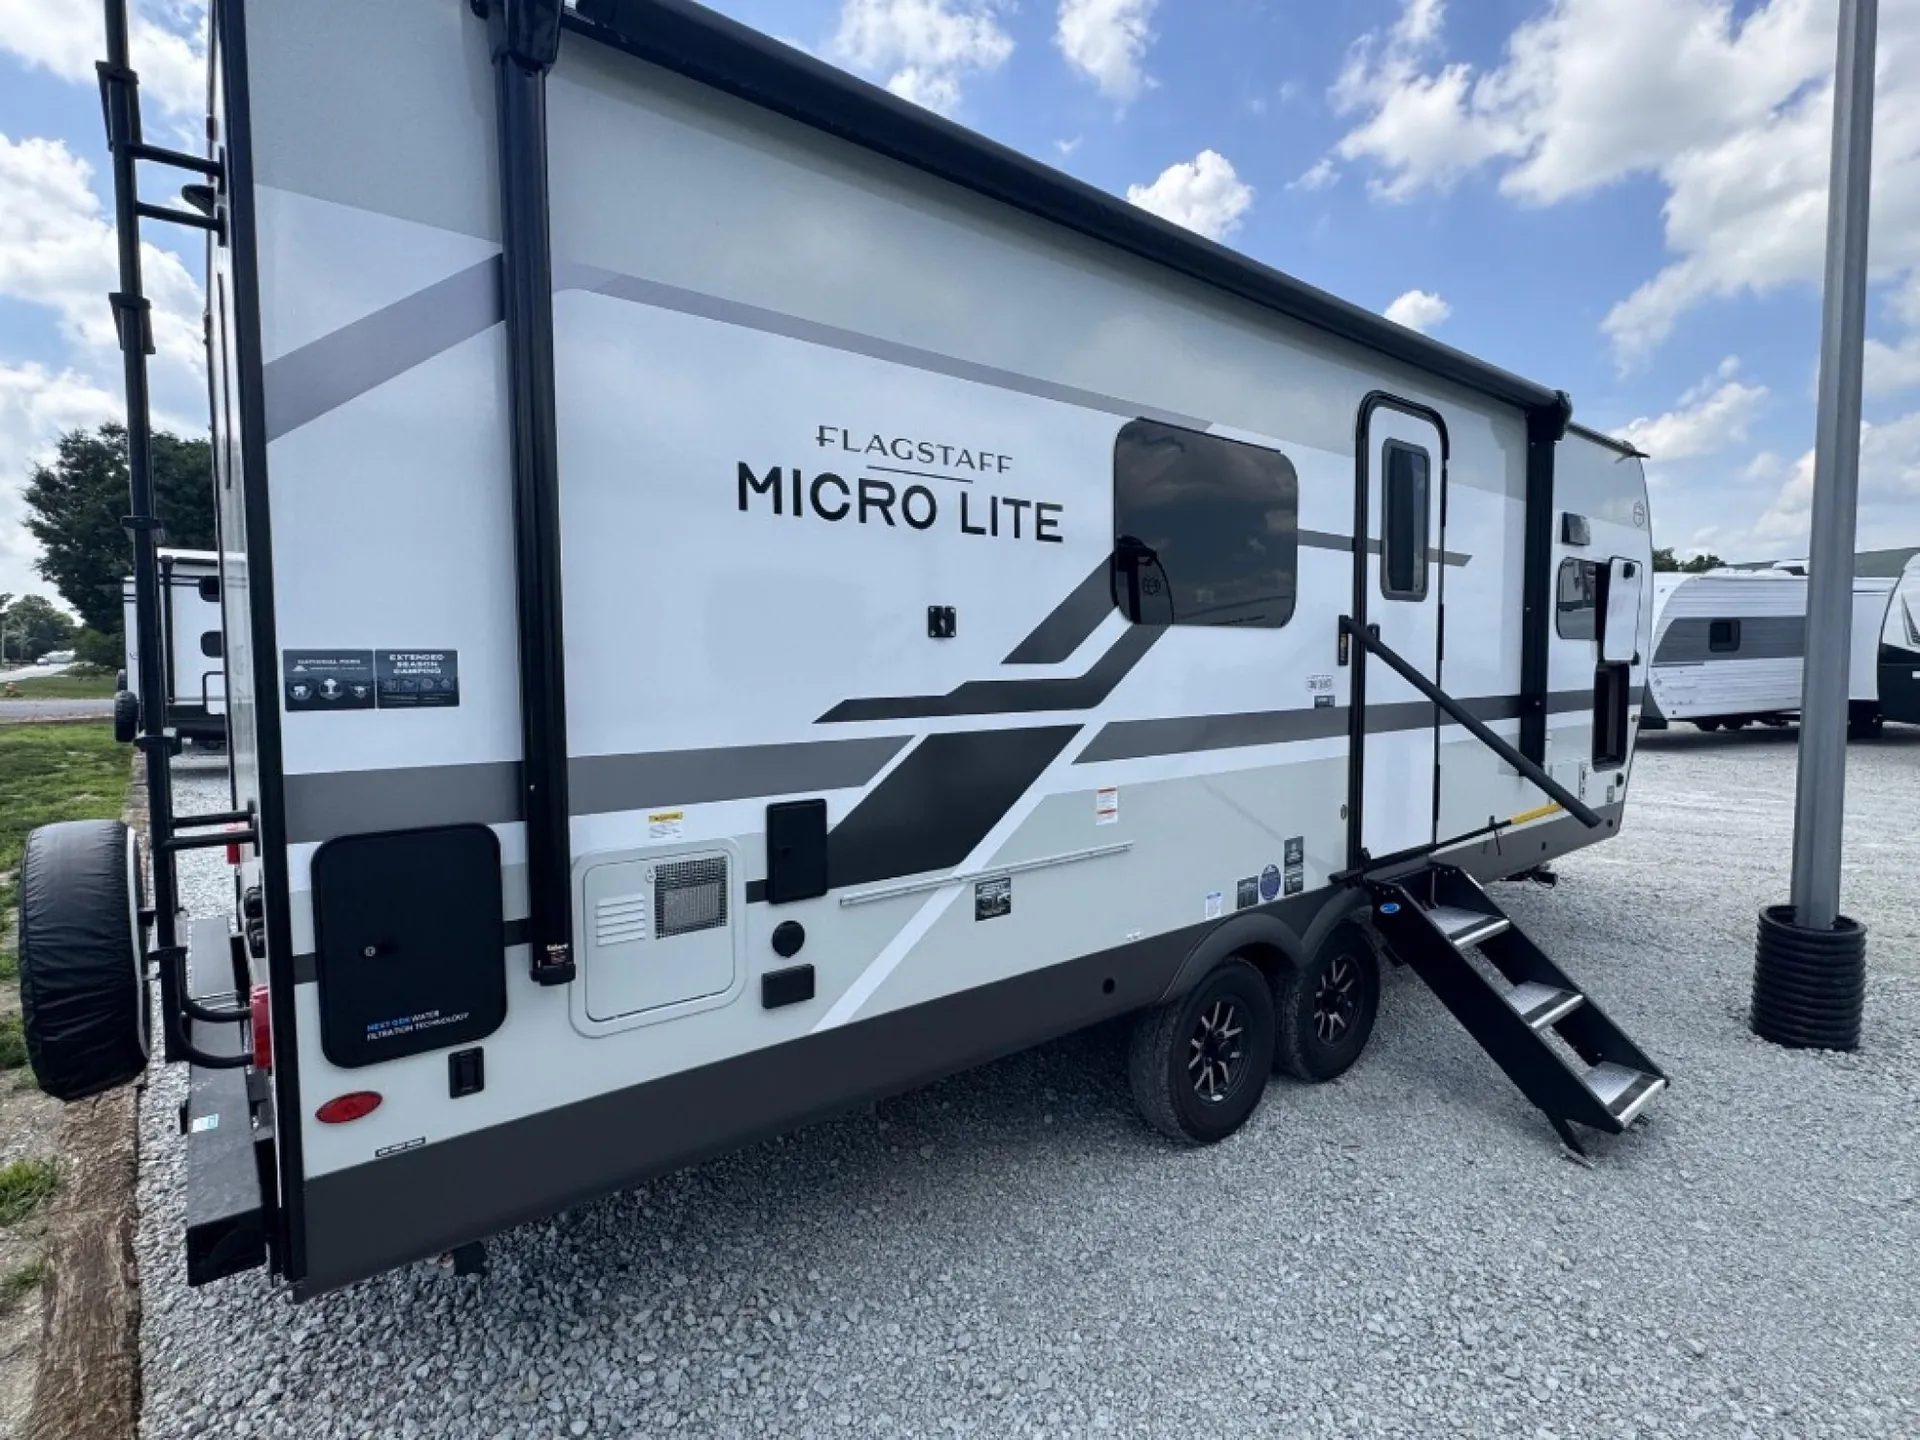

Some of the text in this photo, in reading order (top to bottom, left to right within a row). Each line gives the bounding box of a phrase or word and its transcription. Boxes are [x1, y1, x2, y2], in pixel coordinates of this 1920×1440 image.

[815, 425, 1013, 473] FLAGSTAFF
[737, 461, 1064, 543] MICRO LITE
[389, 653, 445, 661] EXTENDED
[367, 1021, 390, 1032] NEXT
[411, 1009, 440, 1022] WATER
[367, 1012, 469, 1042] FILTRATION TECHNOLOGY
